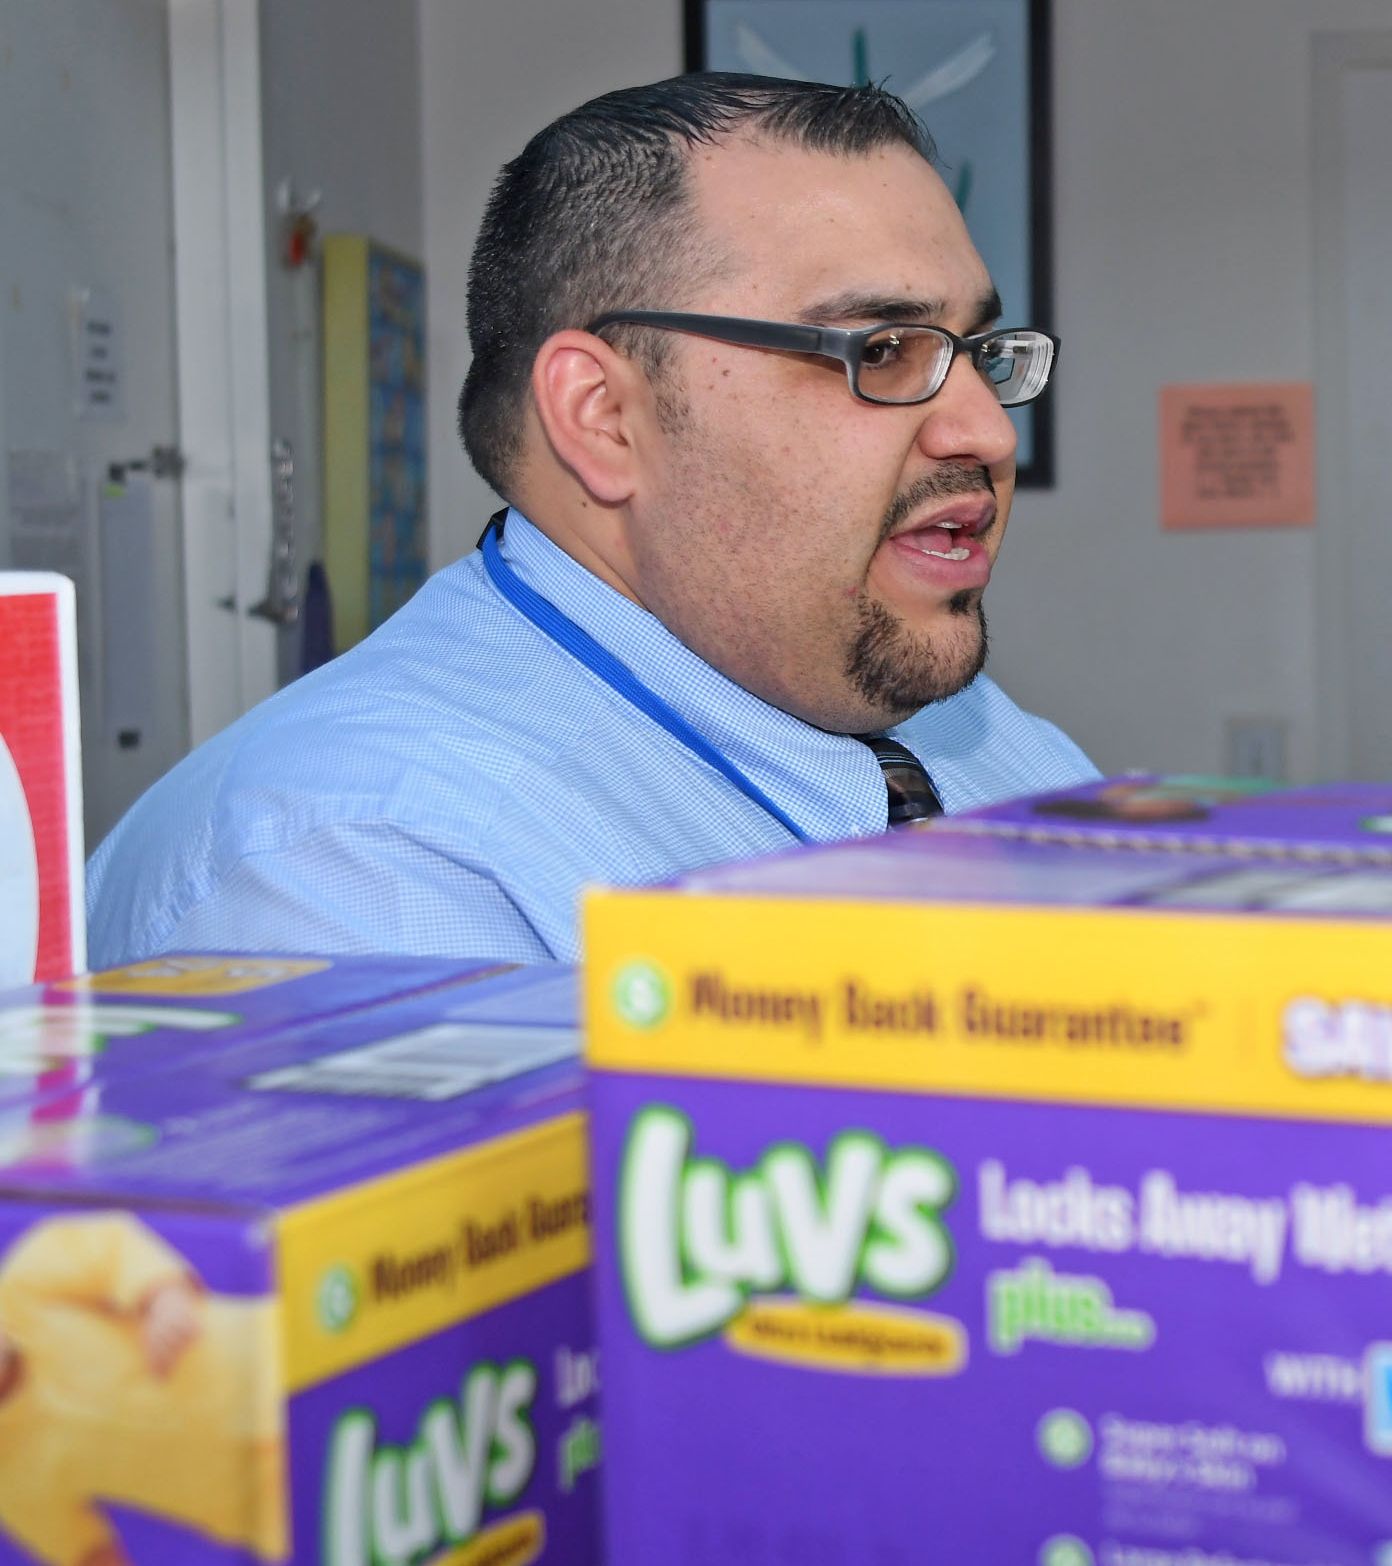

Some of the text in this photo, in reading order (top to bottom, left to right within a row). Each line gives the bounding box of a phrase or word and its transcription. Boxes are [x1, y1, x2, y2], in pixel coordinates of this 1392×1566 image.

[686, 970, 822, 1042] Money
[840, 978, 938, 1034] Back
[464, 1210, 520, 1270] Back
[978, 1161, 1132, 1249] Locks
[1137, 1170, 1285, 1279] Away
[1268, 1353, 1358, 1395] WITH
